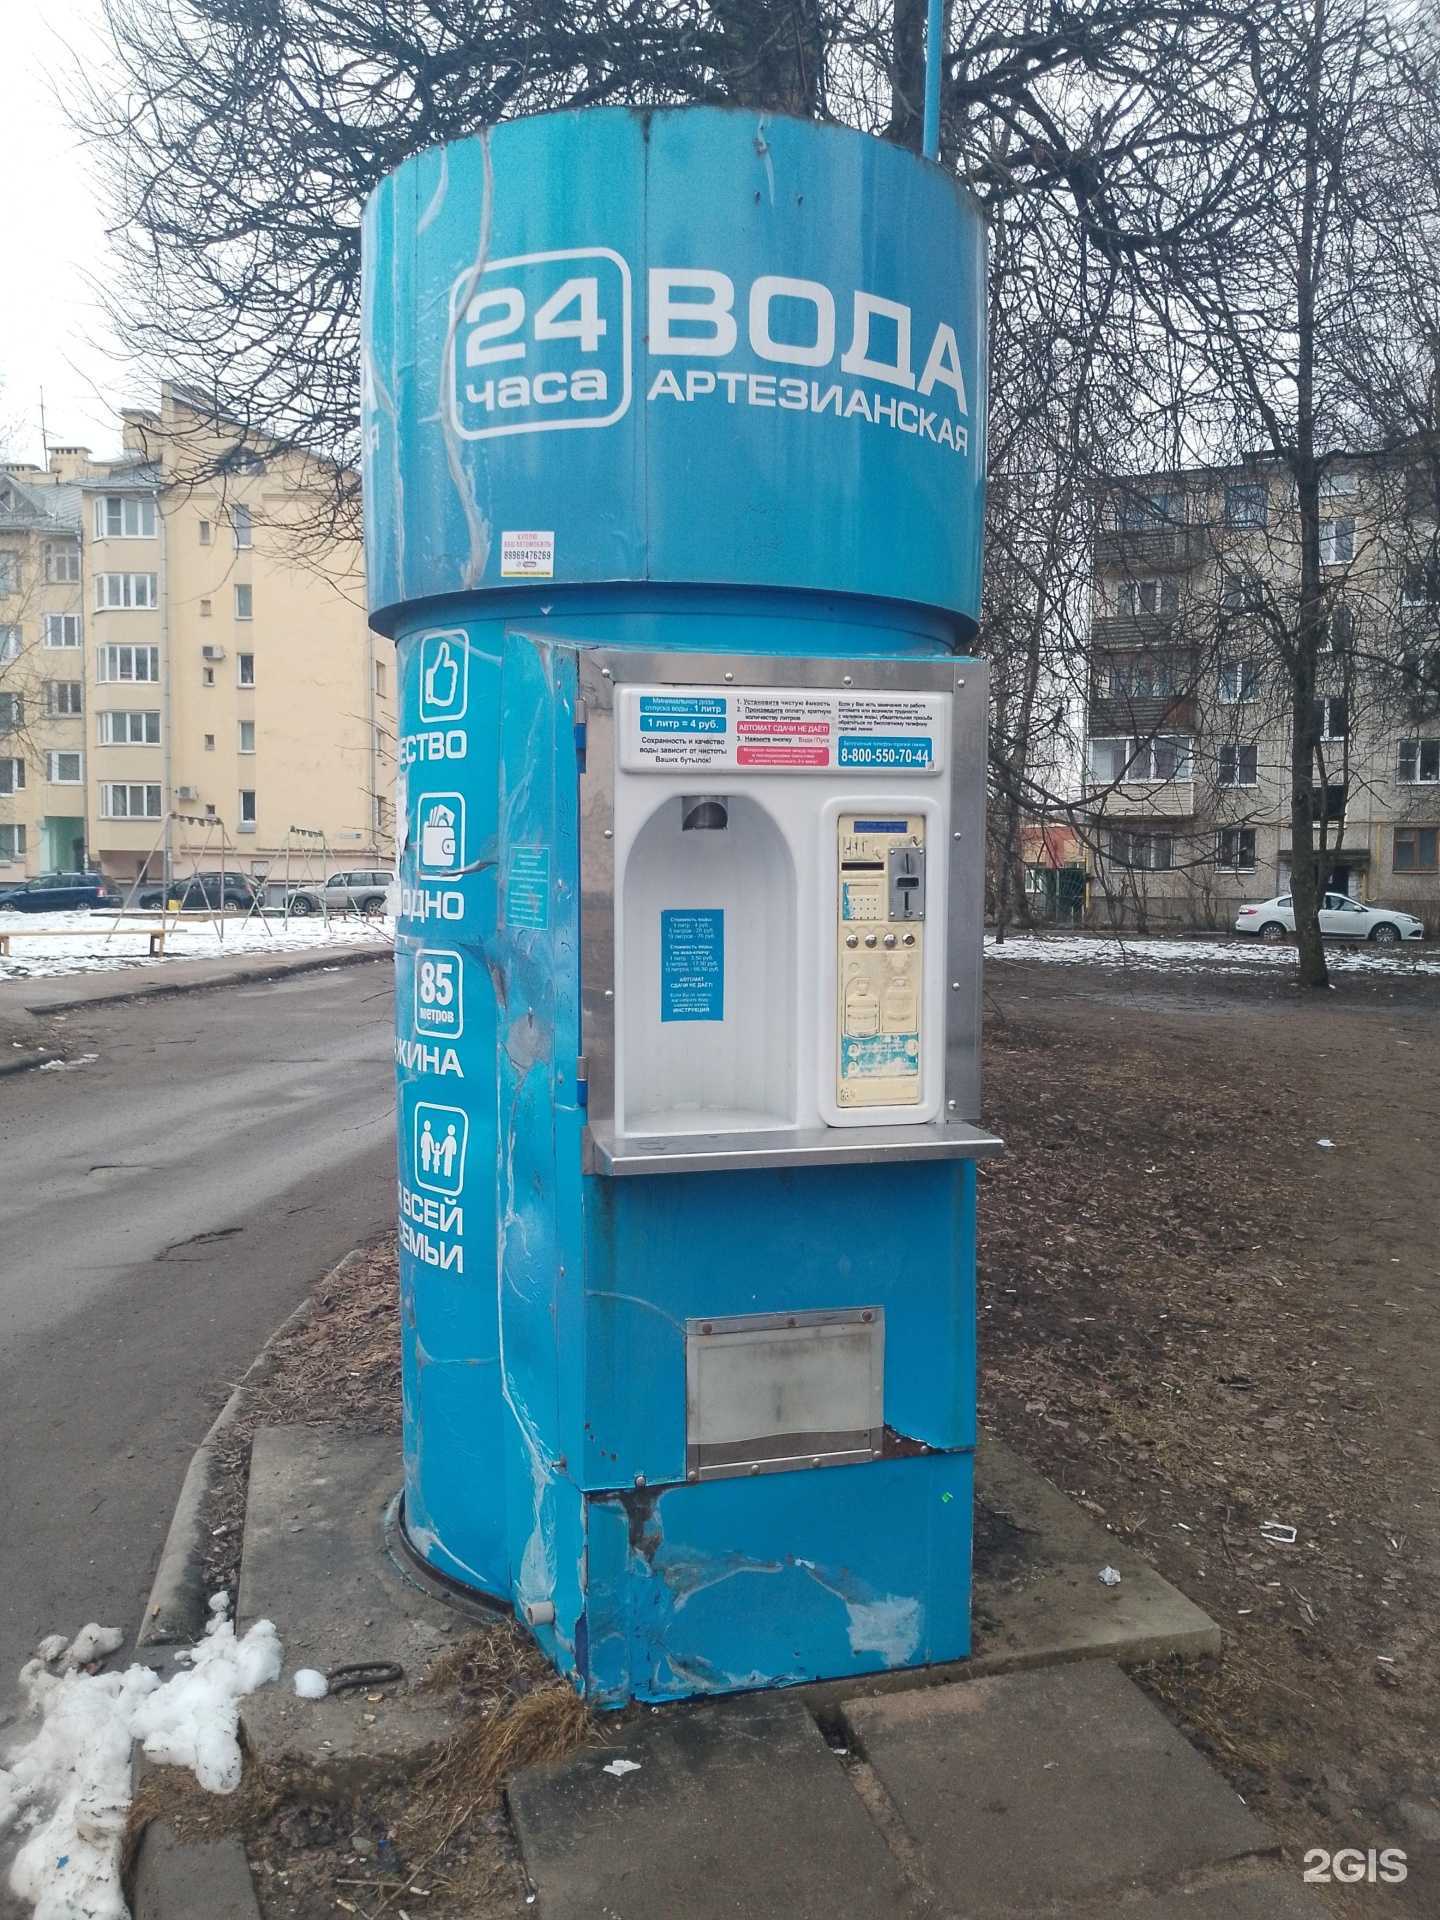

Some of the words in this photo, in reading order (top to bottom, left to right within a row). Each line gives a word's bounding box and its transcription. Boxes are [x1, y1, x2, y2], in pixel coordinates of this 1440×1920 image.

[465, 277, 607, 369] 24
[648, 268, 969, 416] ВОДА
[466, 369, 609, 413] часа
[646, 369, 969, 458] АРТЕЗИАНСКАЯ
[701, 706, 722, 714] литр
[743, 698, 779, 706] Установите
[656, 720, 680, 729] литр
[690, 719, 696, 728] 4
[698, 719, 719, 730] руб.
[739, 724, 772, 732] АВТОМАТ
[773, 724, 797, 733] СДАЧИ
[641, 736, 687, 745] Сохранность
[655, 755, 678, 763] Ваших
[841, 748, 928, 764] 8-800-550-70-44
[420, 962, 453, 1006] 85
[419, 1007, 455, 1025] метров
